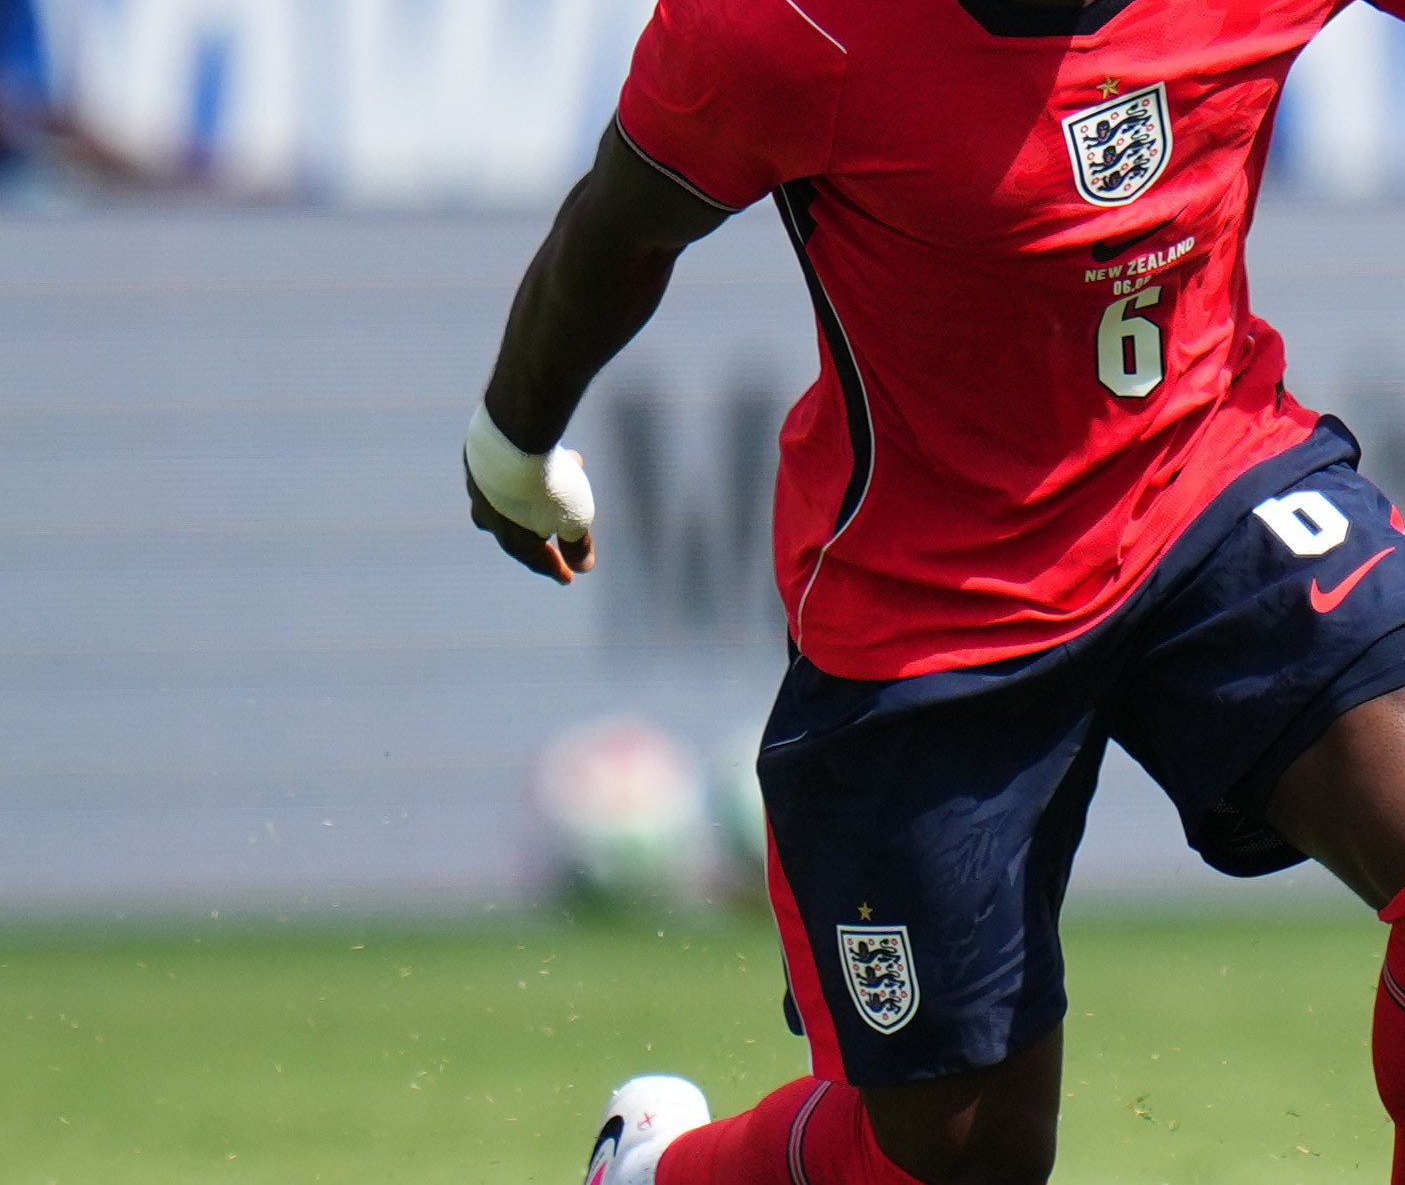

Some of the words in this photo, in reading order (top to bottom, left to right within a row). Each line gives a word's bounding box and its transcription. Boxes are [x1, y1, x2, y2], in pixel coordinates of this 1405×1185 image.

[1084, 265, 1123, 282] NEW
[1127, 236, 1196, 276] ZEALAND
[1096, 285, 1164, 398] 6
